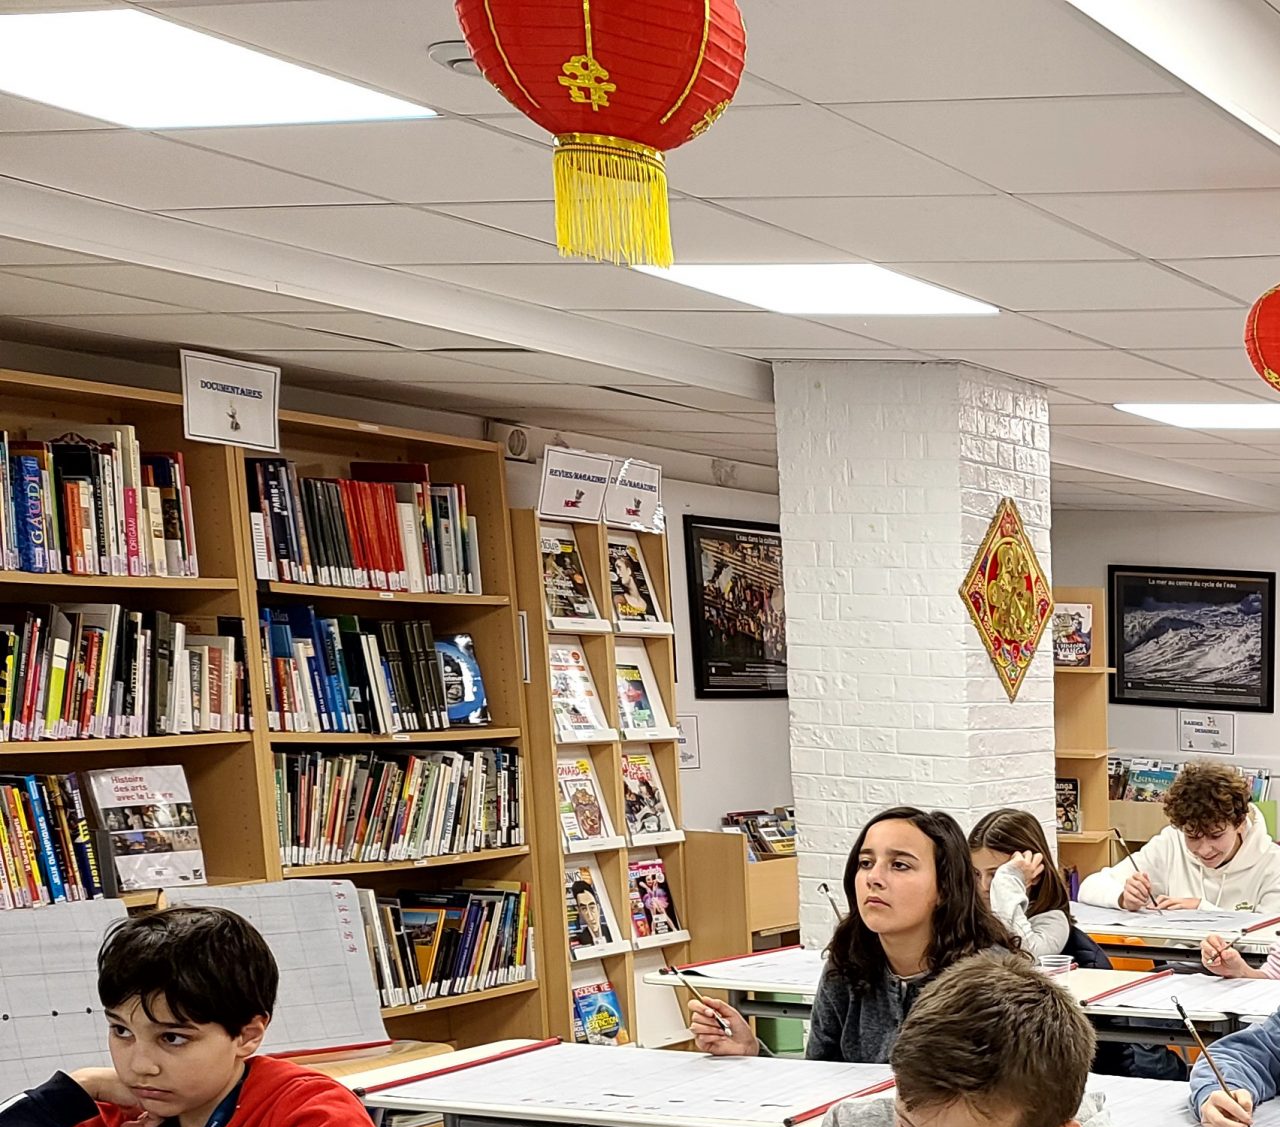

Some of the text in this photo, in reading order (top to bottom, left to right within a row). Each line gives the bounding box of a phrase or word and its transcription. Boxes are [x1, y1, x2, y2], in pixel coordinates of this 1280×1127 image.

[200, 380, 263, 399] DOCUMENTAIRES
[131, 517, 139, 555] ORIGAMI
[111, 775, 144, 784] Histoire
[114, 784, 148, 793] des arts
[116, 793, 137, 801] avec
[39, 816, 60, 885] JEUX OLYMPIQUES
